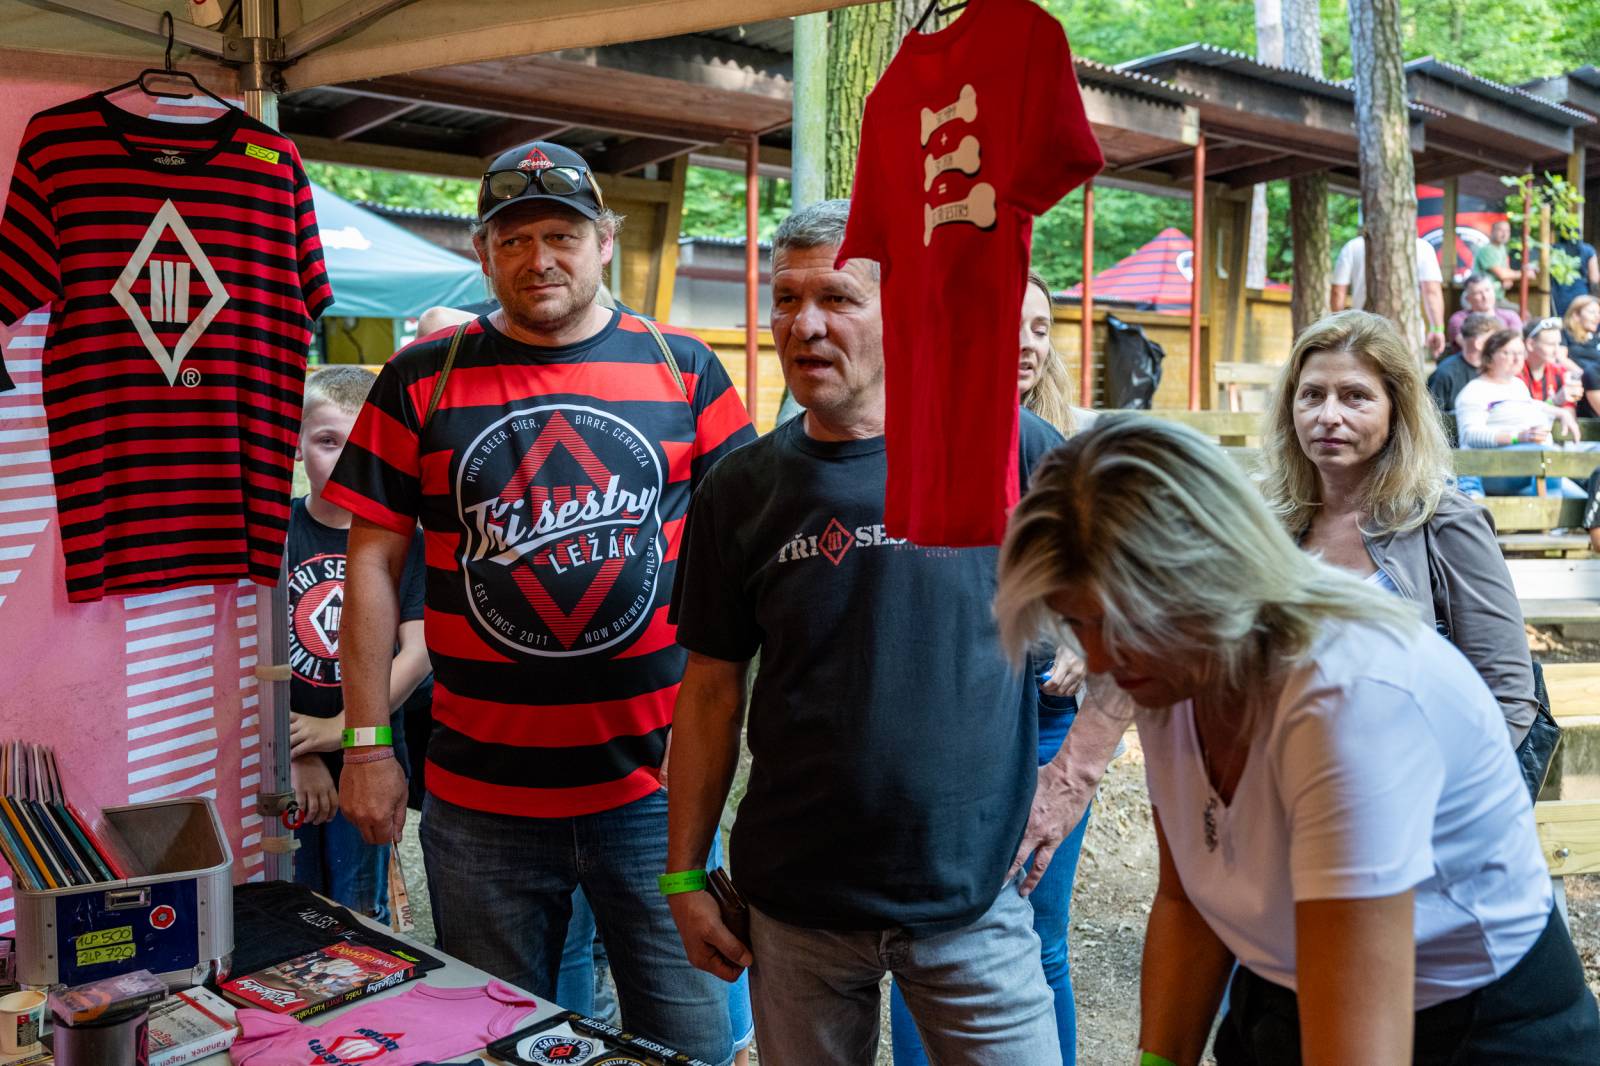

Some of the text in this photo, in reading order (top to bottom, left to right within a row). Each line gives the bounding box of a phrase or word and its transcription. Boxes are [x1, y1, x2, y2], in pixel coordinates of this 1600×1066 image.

[248, 144, 275, 160] 550
[466, 414, 650, 483] PIVO, BEER, BIER, BIRRE, CERVEZA
[528, 474, 658, 539] sestry
[548, 528, 638, 575] LEŽÁK
[855, 524, 907, 548] SE
[288, 559, 347, 594] TŘI SE
[474, 582, 548, 646] EST. SINCE 2011
[584, 628, 610, 643] NOW
[613, 595, 646, 632] BREWED
[643, 579, 652, 594] IN
[401, 905, 414, 927] 200
[102, 929, 131, 943] 500
[105, 946, 134, 959] 720
